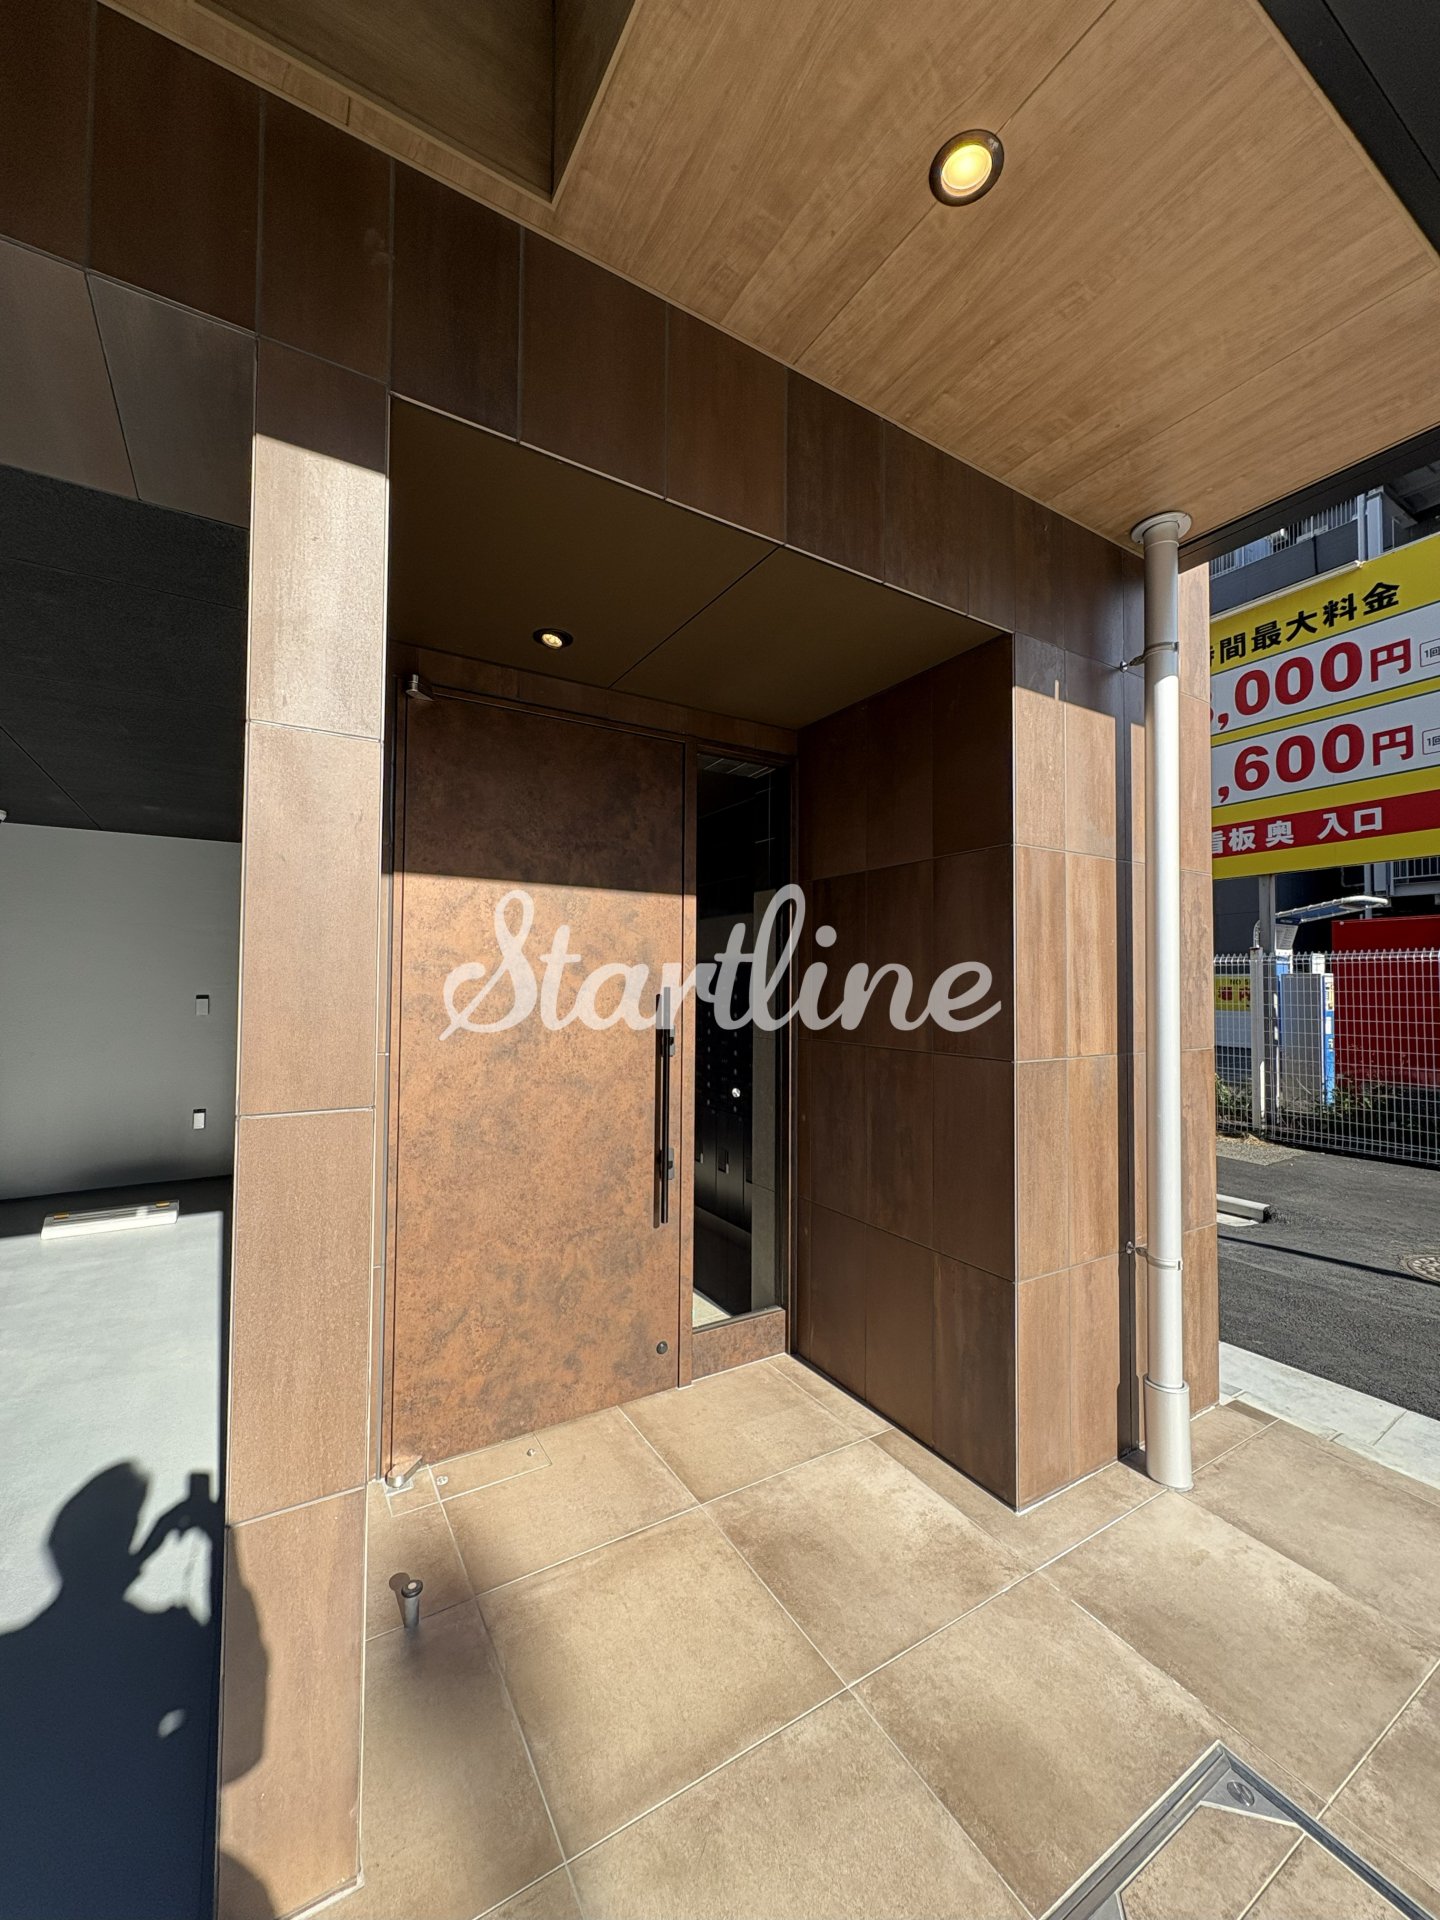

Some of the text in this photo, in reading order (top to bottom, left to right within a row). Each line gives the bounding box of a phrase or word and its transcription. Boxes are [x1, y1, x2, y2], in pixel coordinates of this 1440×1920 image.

[1210, 582, 1400, 667] 間最大料金
[1210, 638, 1411, 730] ,000円
